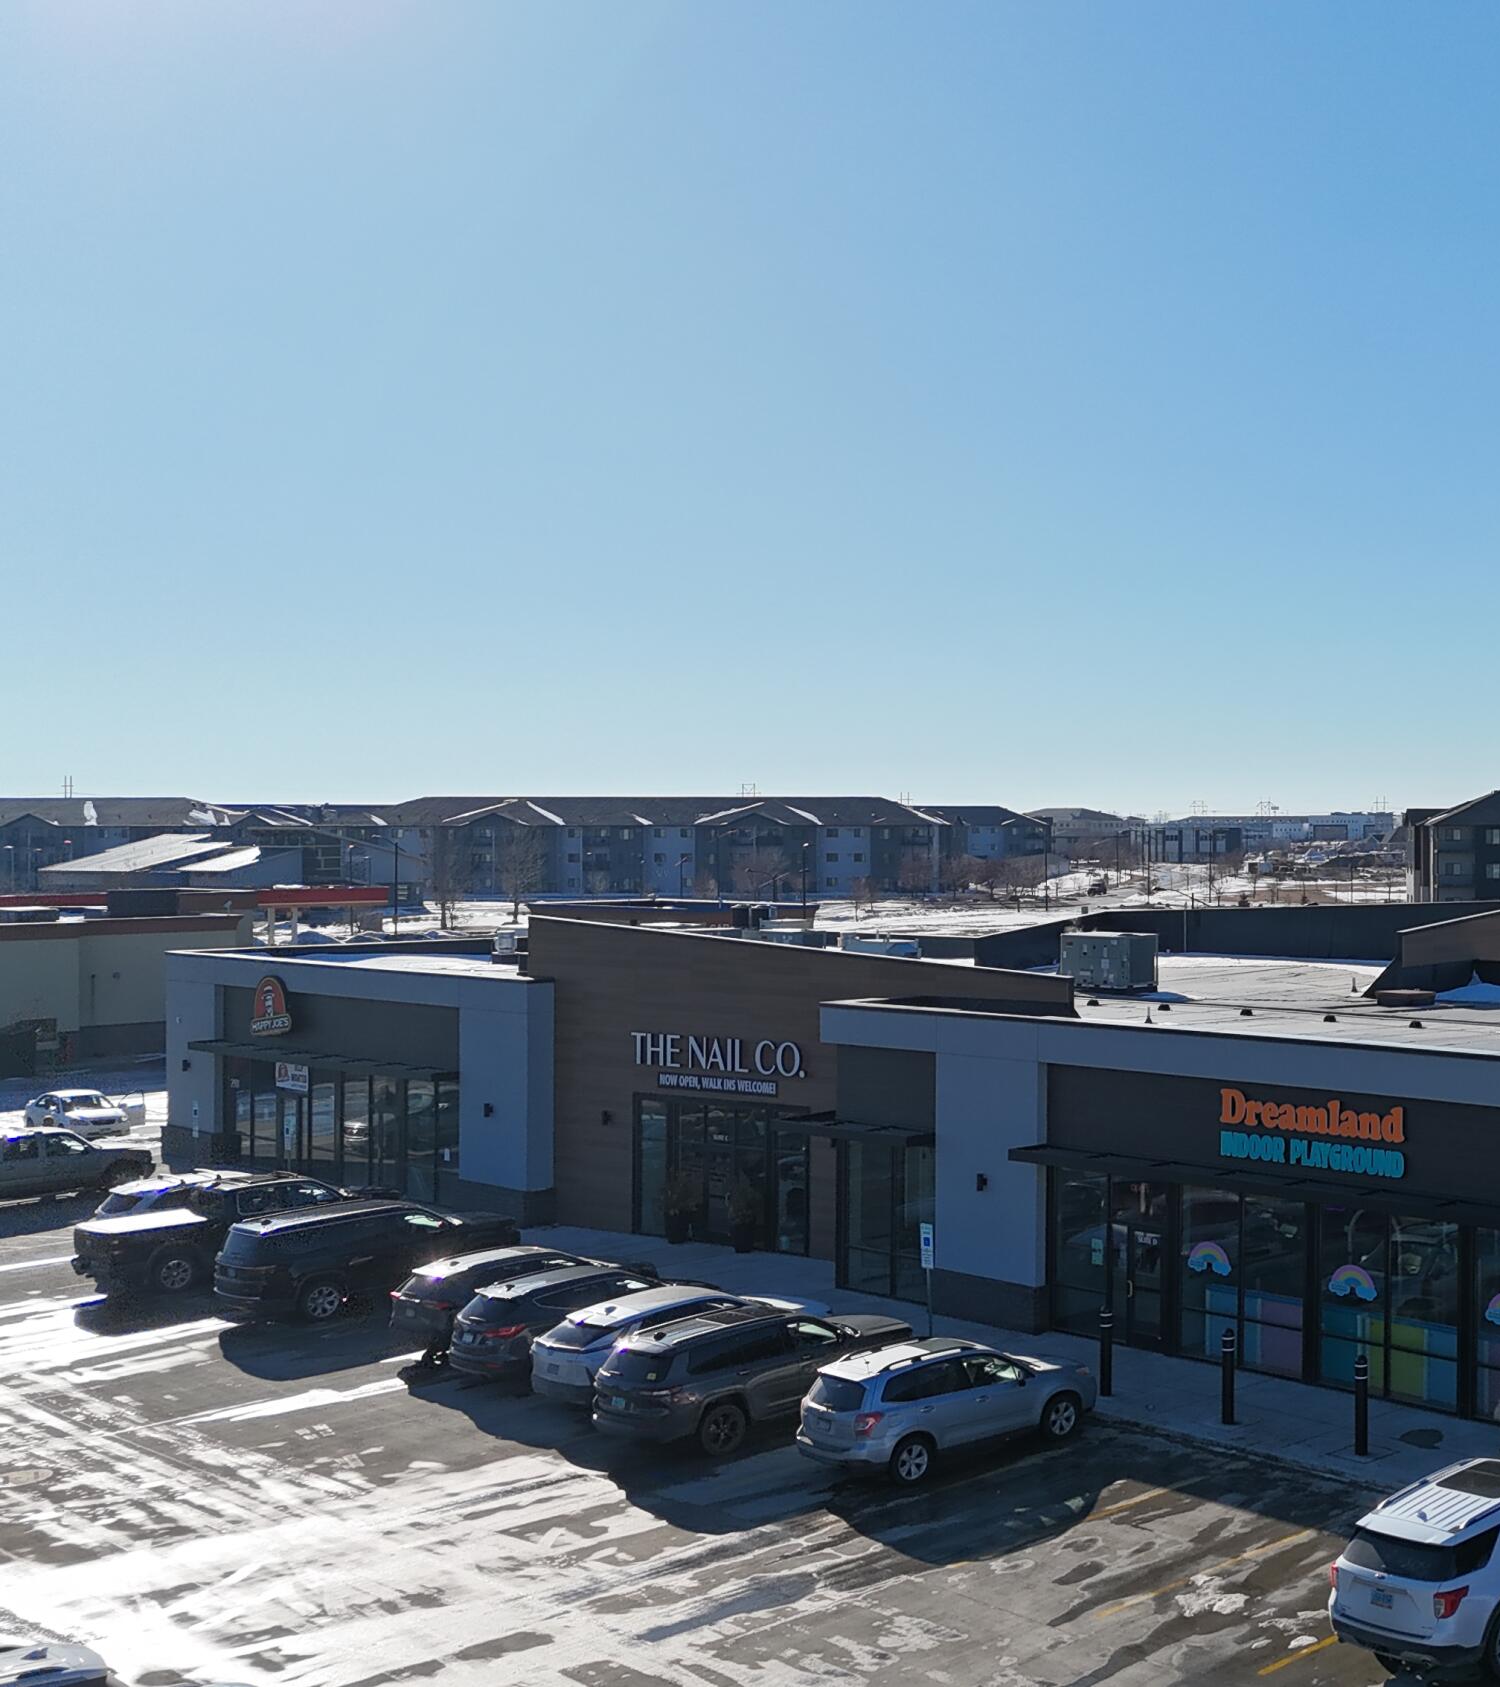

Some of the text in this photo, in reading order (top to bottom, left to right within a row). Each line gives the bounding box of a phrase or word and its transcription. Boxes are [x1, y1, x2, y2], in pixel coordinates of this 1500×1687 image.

[630, 1031, 806, 1079] THE NAIL CO.
[659, 1073, 678, 1087] NOW
[701, 1076, 723, 1091] WALK
[723, 1079, 736, 1092] INS
[1219, 1087, 1406, 1144] Dreamland
[1219, 1130, 1405, 1178] INDOOR PLAYGROUND
